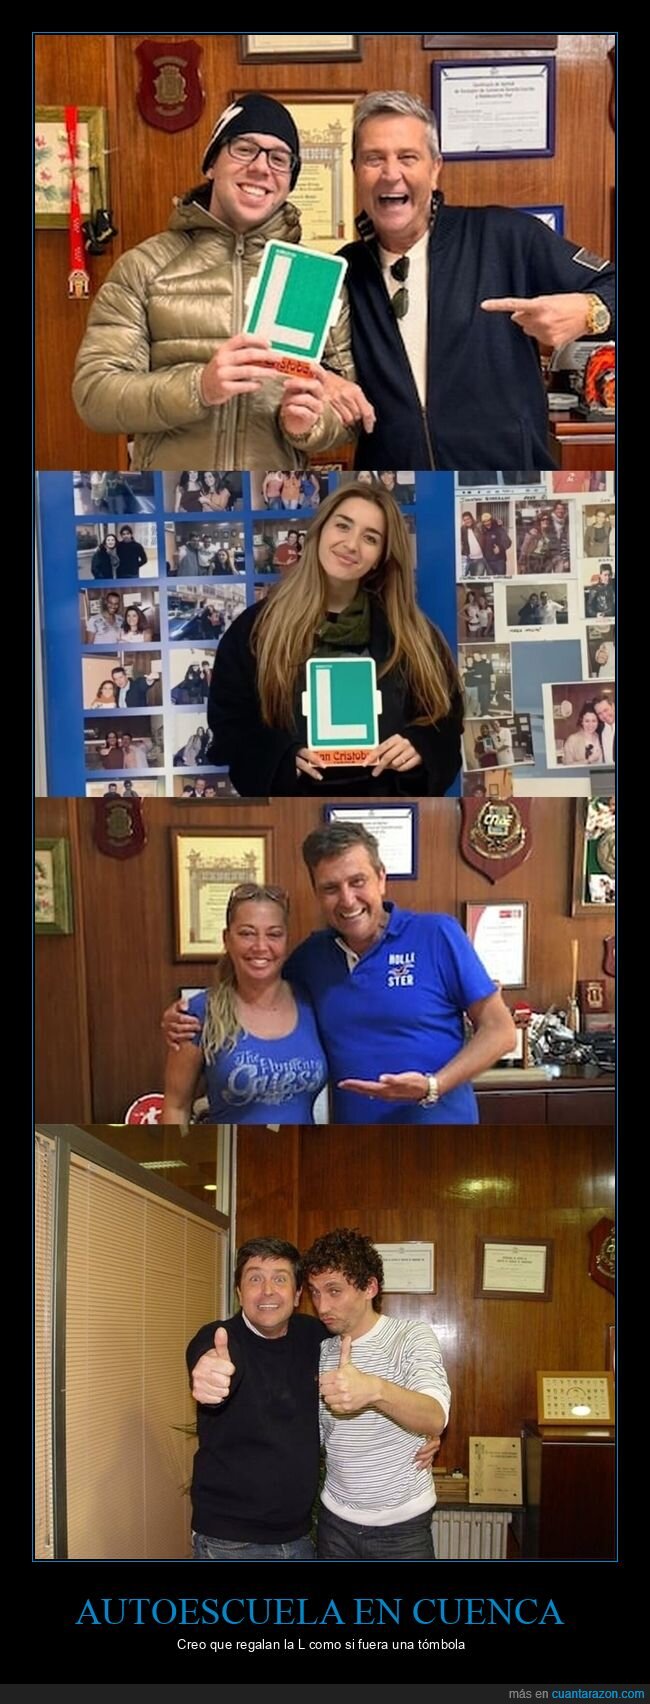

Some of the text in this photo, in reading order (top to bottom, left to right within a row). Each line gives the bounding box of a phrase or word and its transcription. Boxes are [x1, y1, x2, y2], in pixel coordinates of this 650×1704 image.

[251, 254, 315, 351] L
[315, 668, 368, 741] L
[333, 751, 369, 761] Cristob
[388, 974, 414, 987] STER
[233, 1050, 260, 1065] The
